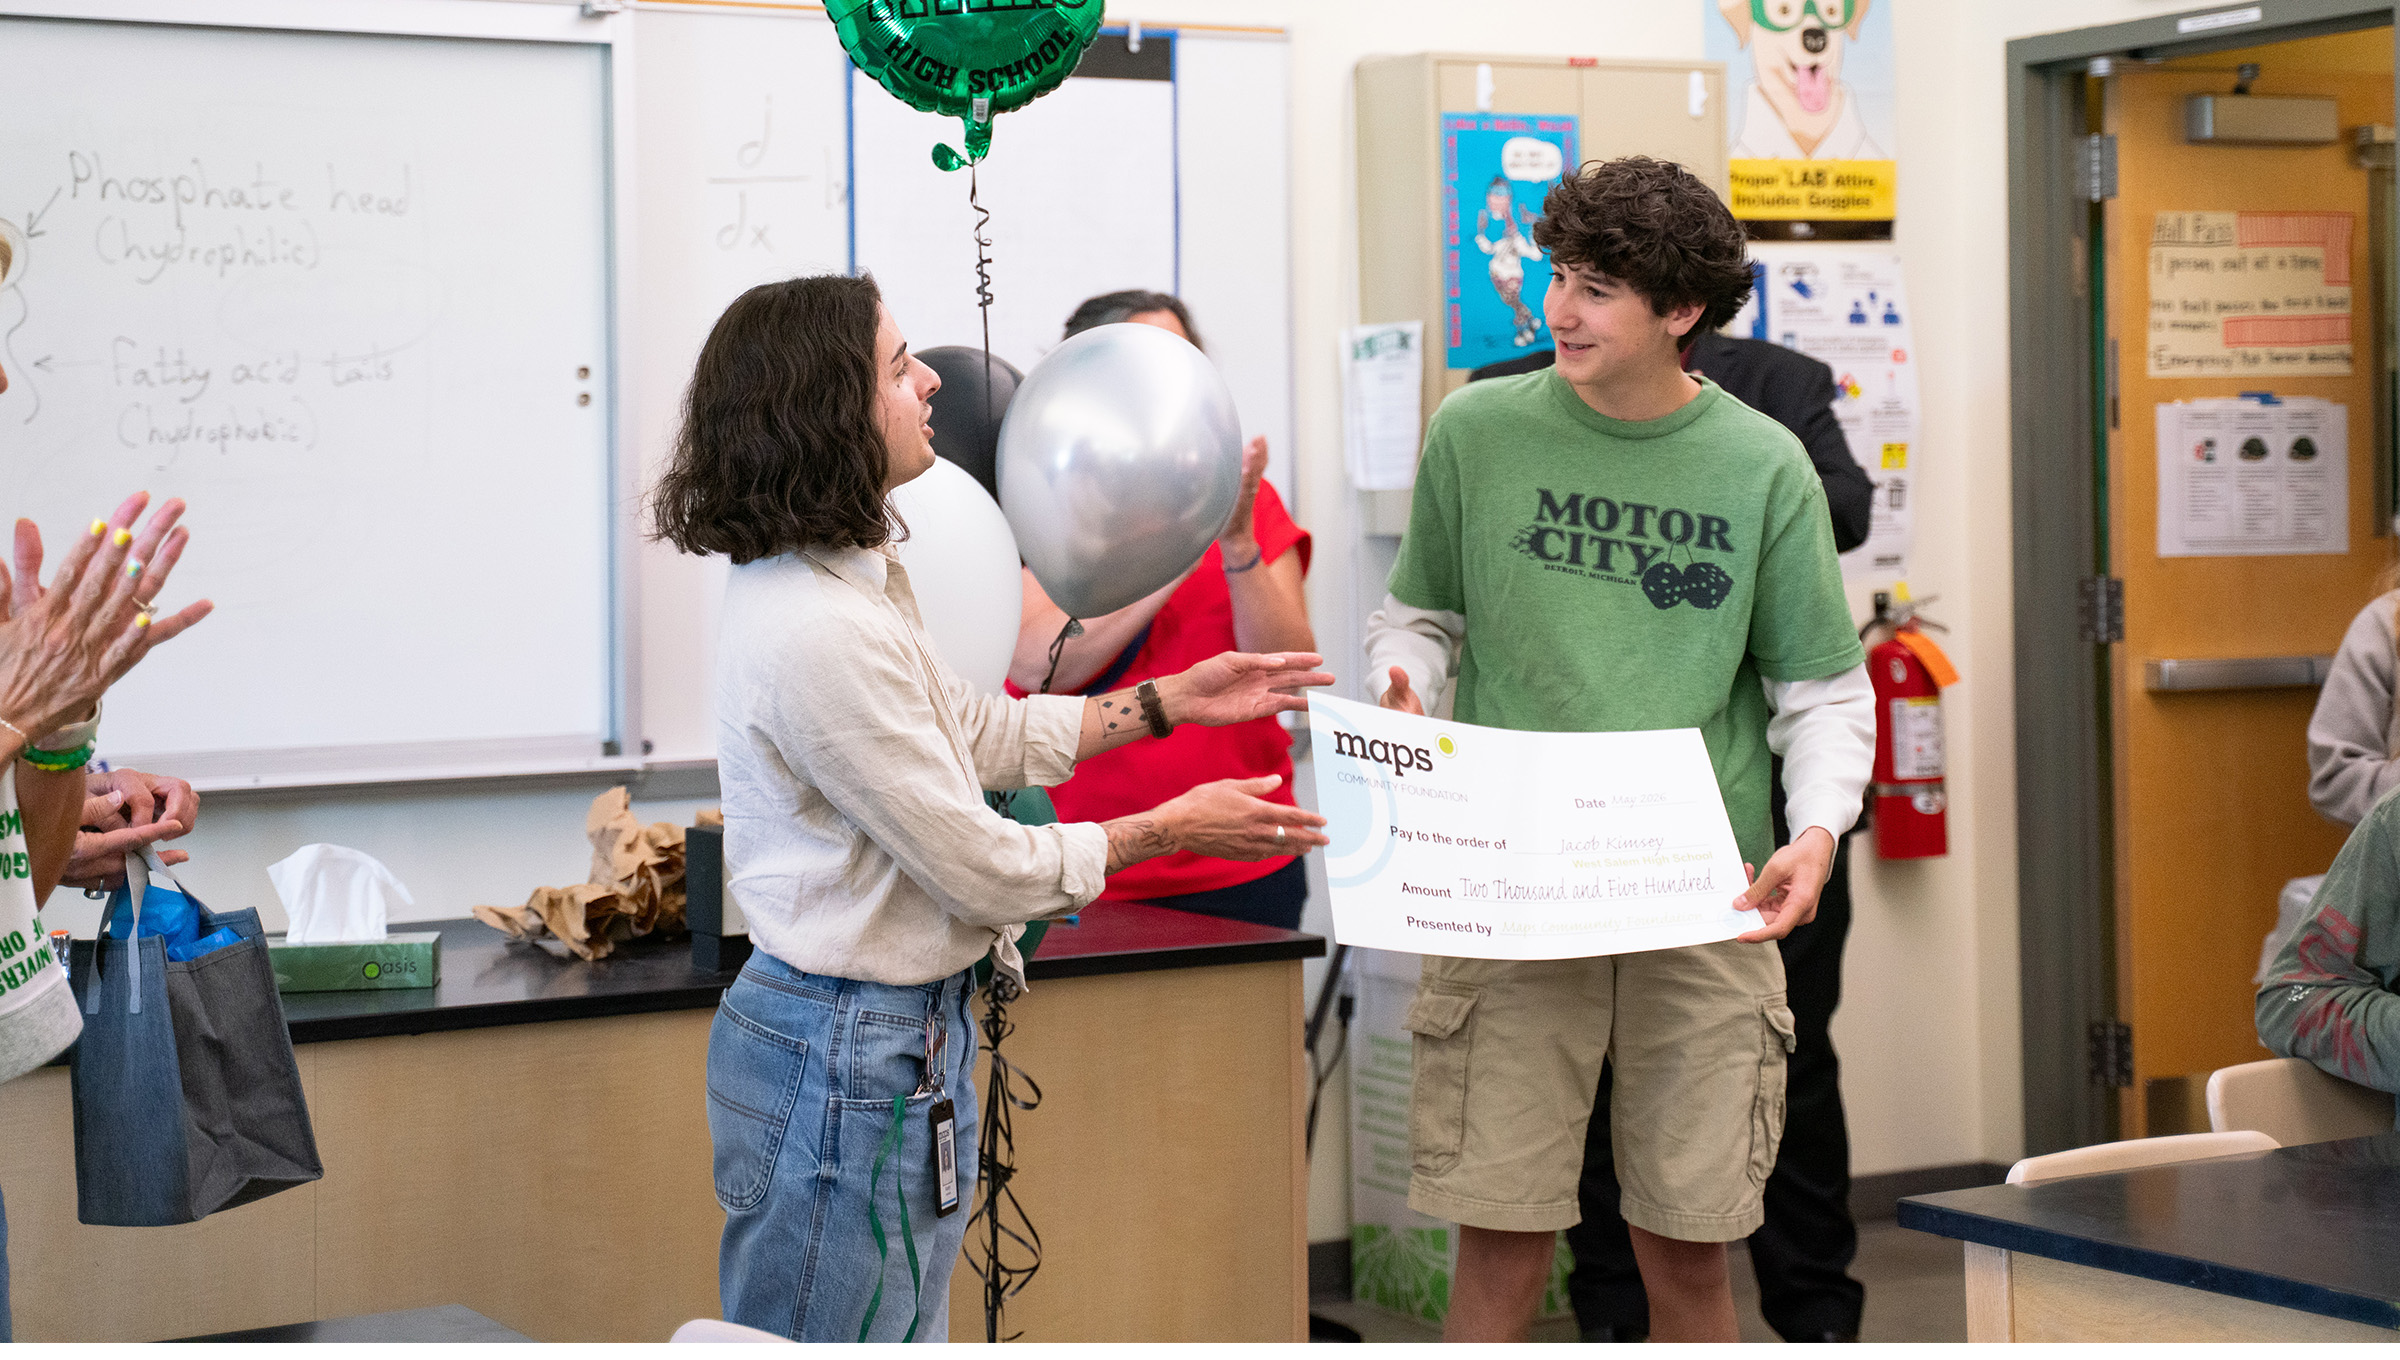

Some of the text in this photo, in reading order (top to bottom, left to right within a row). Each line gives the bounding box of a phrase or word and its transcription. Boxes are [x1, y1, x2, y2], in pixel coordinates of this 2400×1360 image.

[884, 29, 1075, 94] HIGH SCHOOL
[69, 150, 412, 228] Phosphate head
[96, 215, 322, 285] (hydrophilic)
[112, 336, 394, 404] Fatty acid tails
[1533, 488, 1735, 553] MOTOR
[1526, 525, 1665, 577] CITY
[1588, 571, 1637, 586] MICHIGAN
[1333, 730, 1434, 777] maps
[1337, 771, 1469, 803] COMMUNITY FOUNDATION
[1574, 797, 1606, 809] Date
[1611, 794, 1636, 808] May
[1390, 825, 1665, 857] Pay to the order of Jacob Kimsey
[1572, 850, 1714, 869] West Salem High School
[1401, 868, 1716, 901] Amount Two Thousand and Five Hundred
[1406, 912, 1703, 937] Presented by Maps Community Foundation
